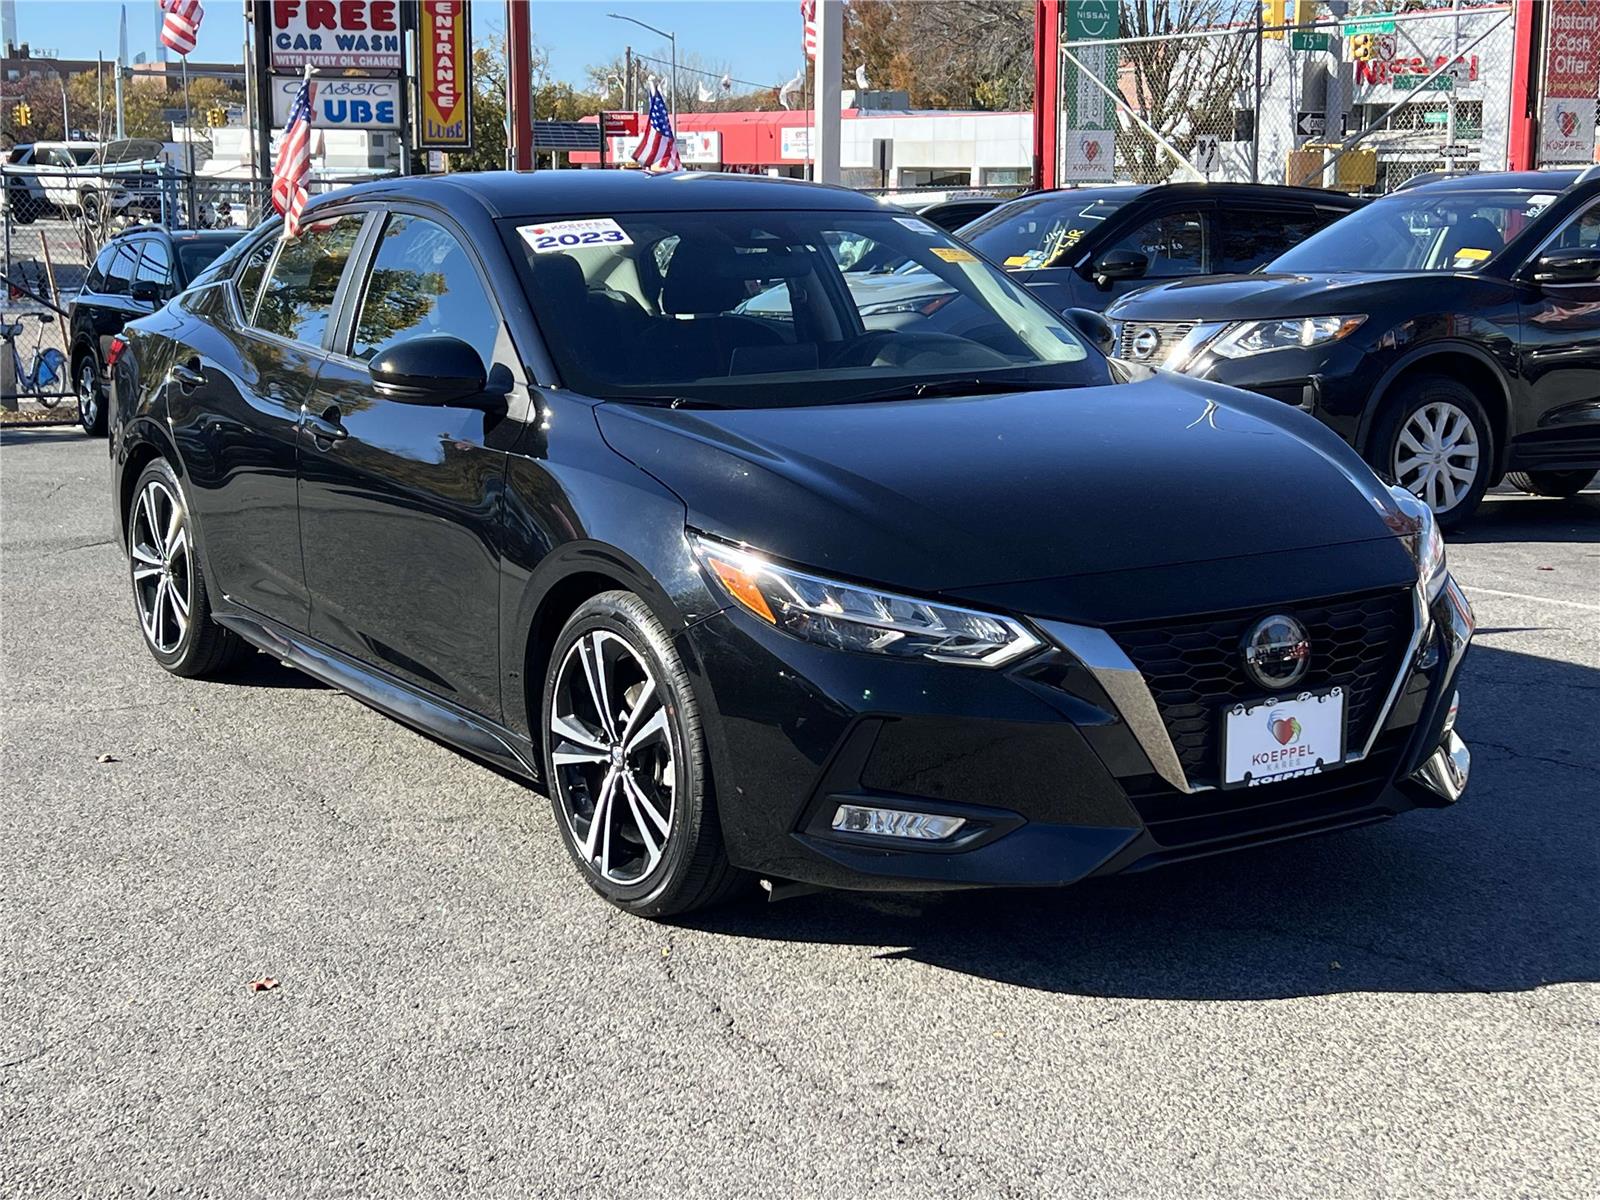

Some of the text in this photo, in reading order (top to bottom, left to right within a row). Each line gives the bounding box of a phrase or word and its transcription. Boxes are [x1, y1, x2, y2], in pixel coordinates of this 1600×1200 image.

[274, 0, 397, 31] FREE
[1077, 11, 1110, 20] NISSAN
[1551, 12, 1598, 32] Instant
[275, 33, 398, 51] CAR WASH
[1302, 34, 1314, 49] 75
[1556, 33, 1591, 52] Cash
[275, 55, 399, 67] WITH EVERY OIL CHANGE
[435, 2, 454, 108] ENTRANCE
[1555, 55, 1591, 74] Offer
[283, 81, 393, 97] CASSIC
[323, 100, 394, 123] UBE
[428, 119, 463, 138] LUBE
[1546, 141, 1586, 151] KOEPPEL
[550, 220, 611, 231] KOEPPEL
[535, 230, 624, 249] 2023
[1252, 744, 1315, 766] KOEPPEL
[1248, 767, 1322, 787] KOEPPEL
